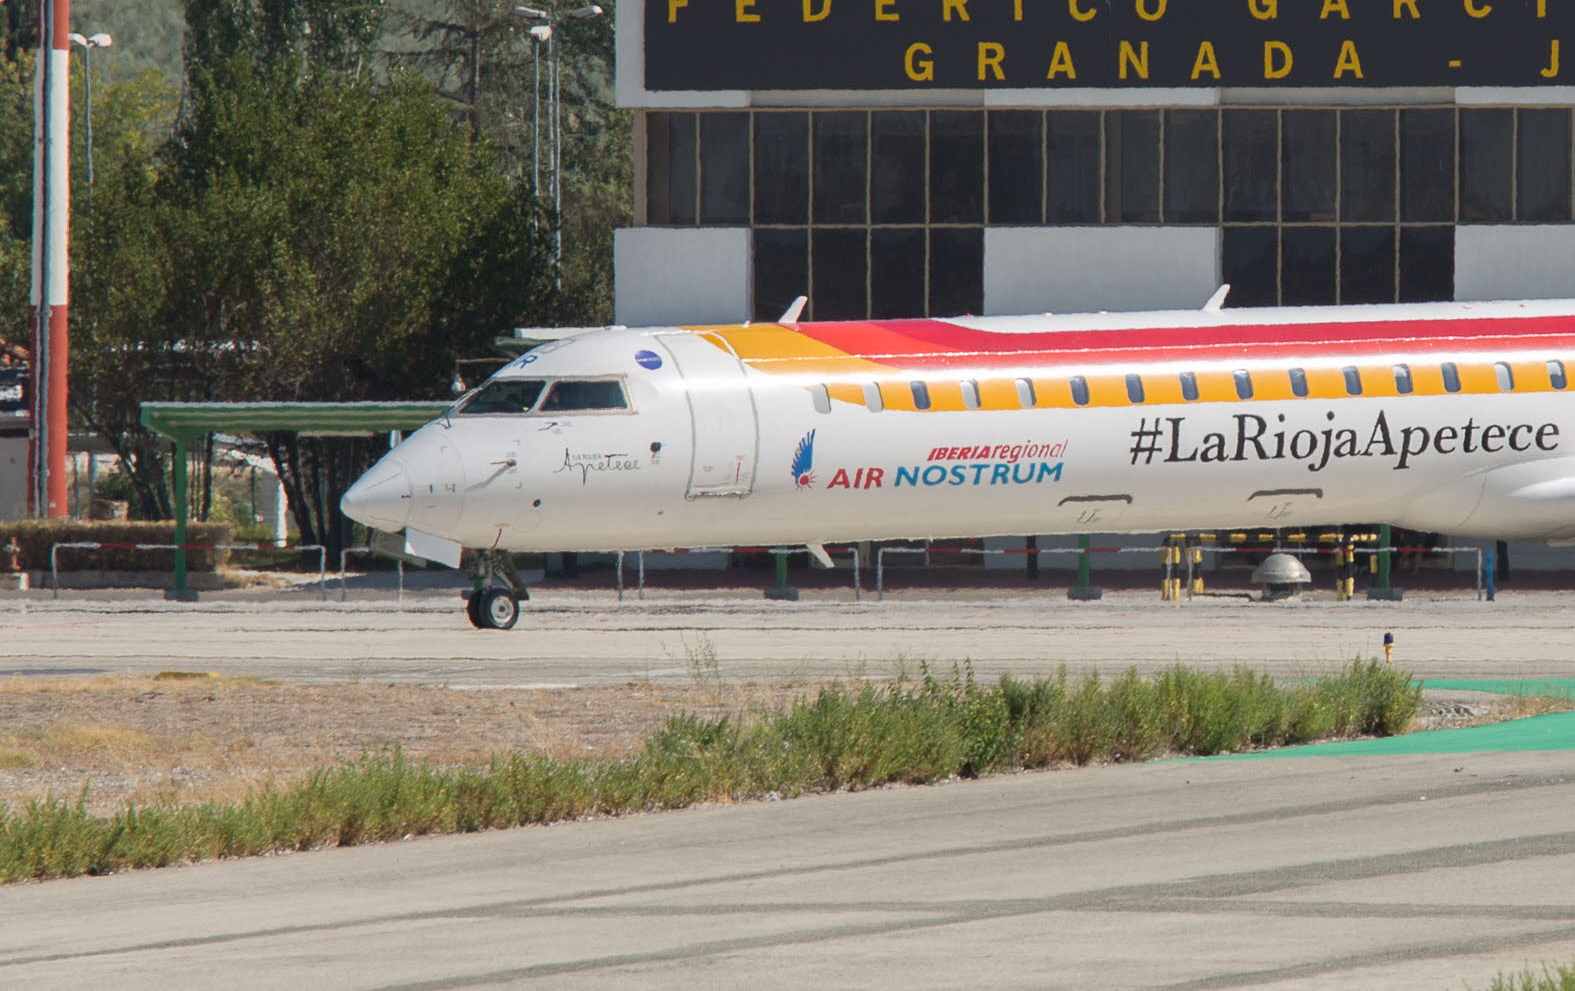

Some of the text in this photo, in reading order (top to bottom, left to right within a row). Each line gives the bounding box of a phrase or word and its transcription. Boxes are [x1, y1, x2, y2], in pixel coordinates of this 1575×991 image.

[904, 40, 1364, 82] GRANADA
[1130, 410, 1559, 472] #LaRiojaApetece
[826, 462, 1065, 490] AIR NOSTRUM
